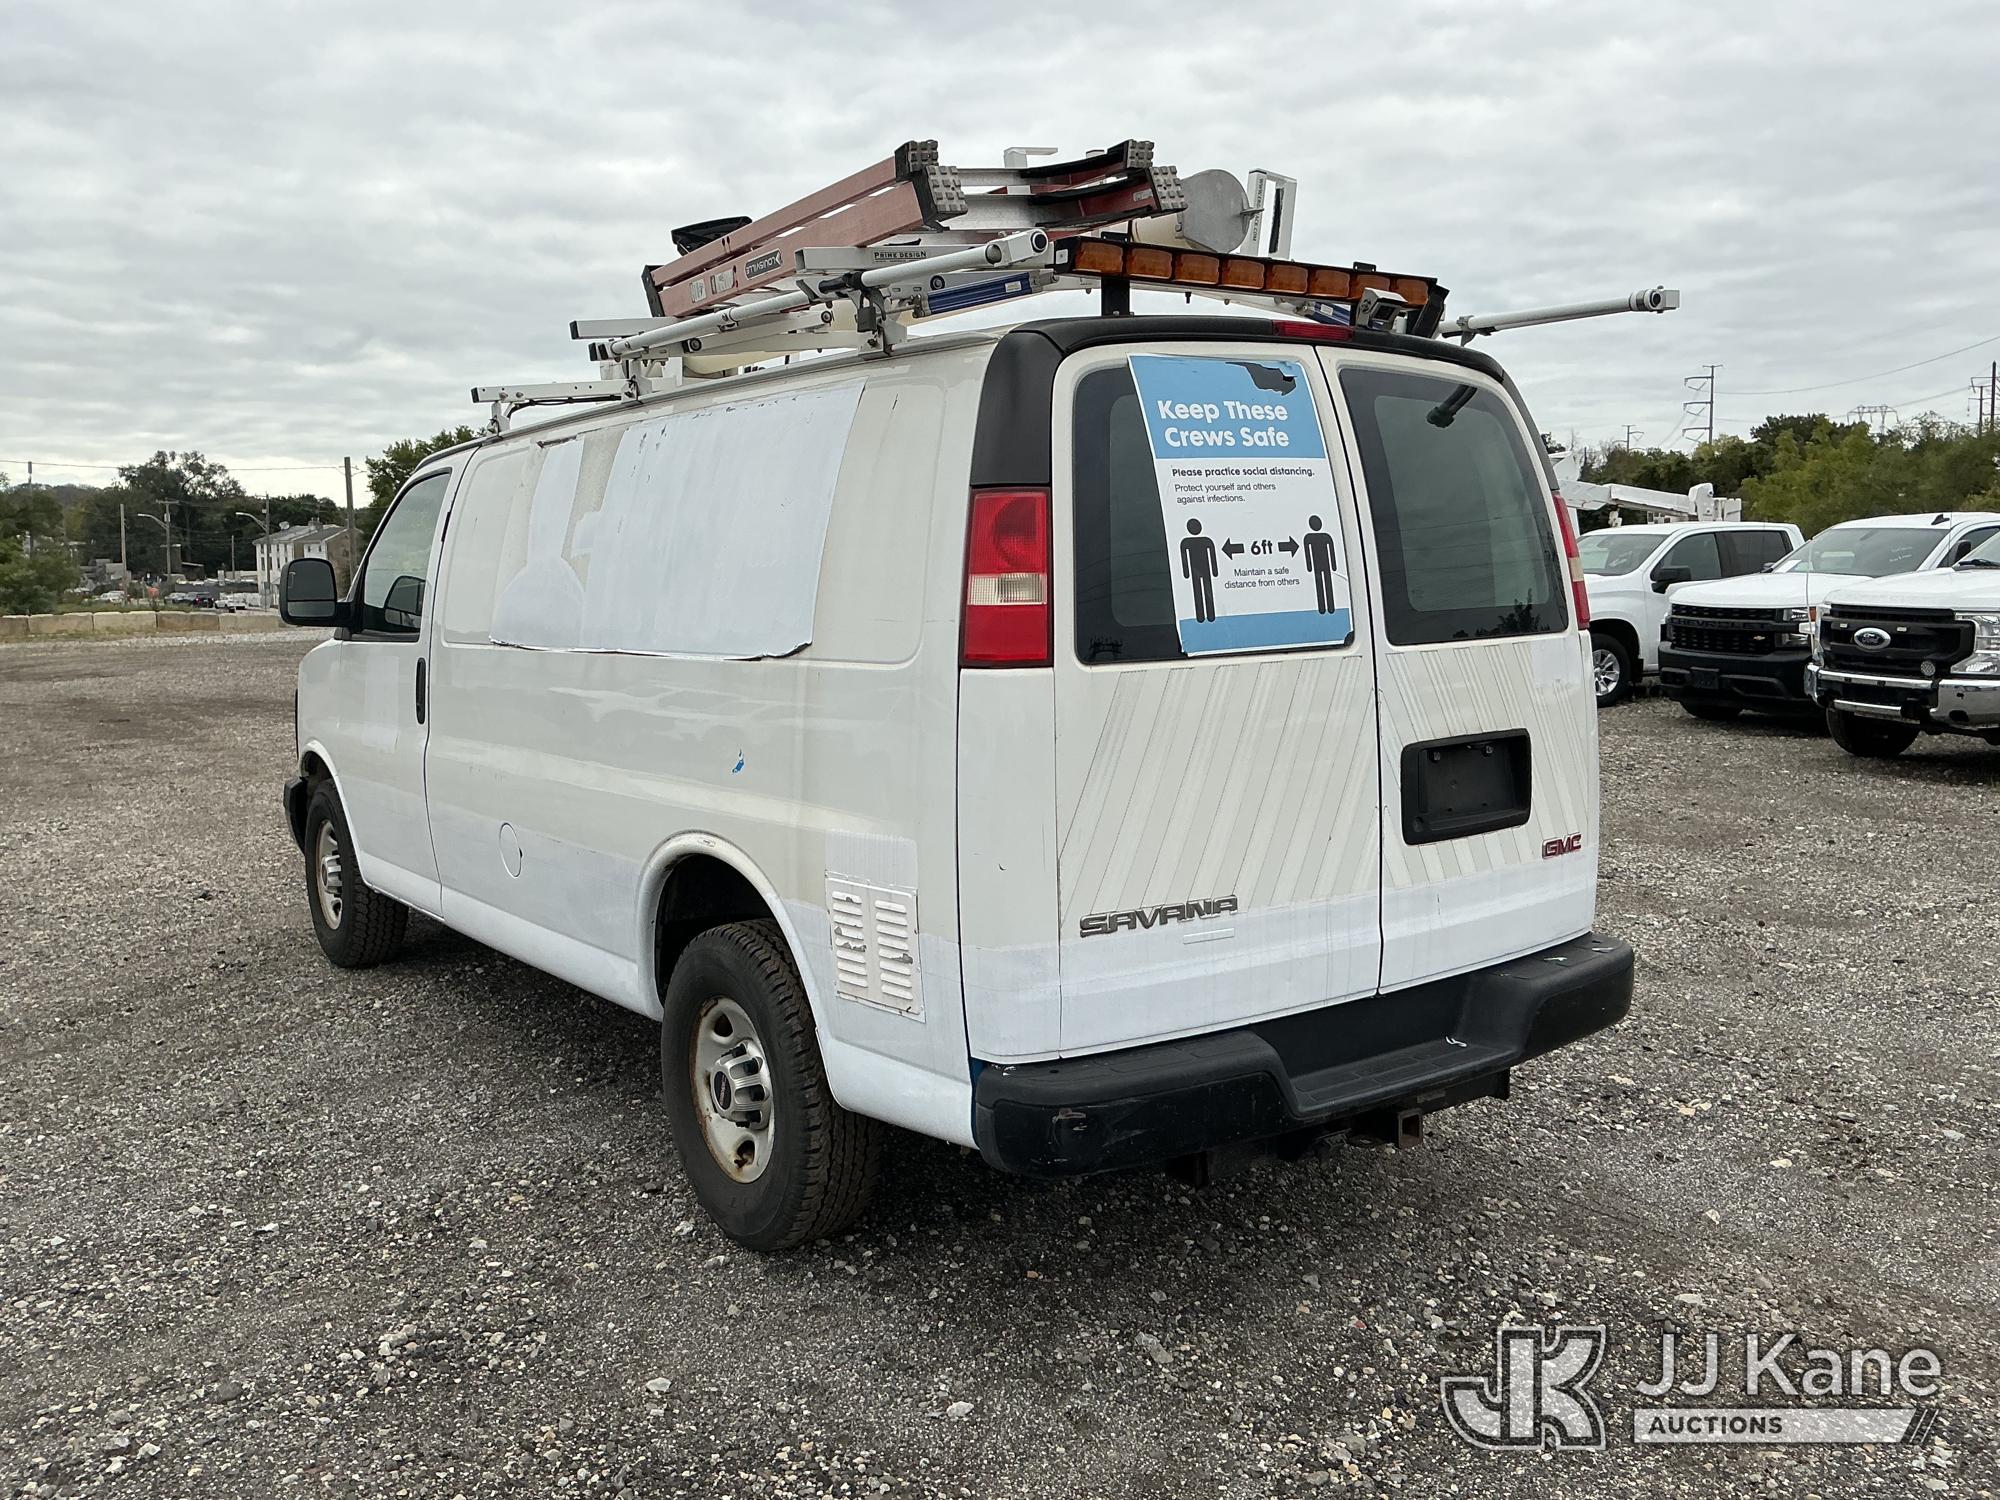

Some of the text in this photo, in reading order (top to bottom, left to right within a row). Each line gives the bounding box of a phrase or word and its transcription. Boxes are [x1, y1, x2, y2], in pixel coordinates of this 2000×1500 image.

[874, 250, 927, 259] PRIME DESIGN
[746, 256, 777, 275] LOUISVILLE
[1157, 400, 1288, 423] Keep These
[1164, 427, 1289, 448] Crews Safe
[1172, 467, 1315, 477] Please practice social distancing.
[1174, 482, 1276, 493] Protect yourself and others
[1176, 494, 1246, 505] against infections.
[1250, 539, 1273, 556] 6ft
[1233, 566, 1265, 577] Maintain
[1274, 565, 1290, 575] safe
[1224, 577, 1300, 589] distance from others
[1543, 832, 1581, 859] GMC
[1080, 895, 1238, 938] SAVANA
